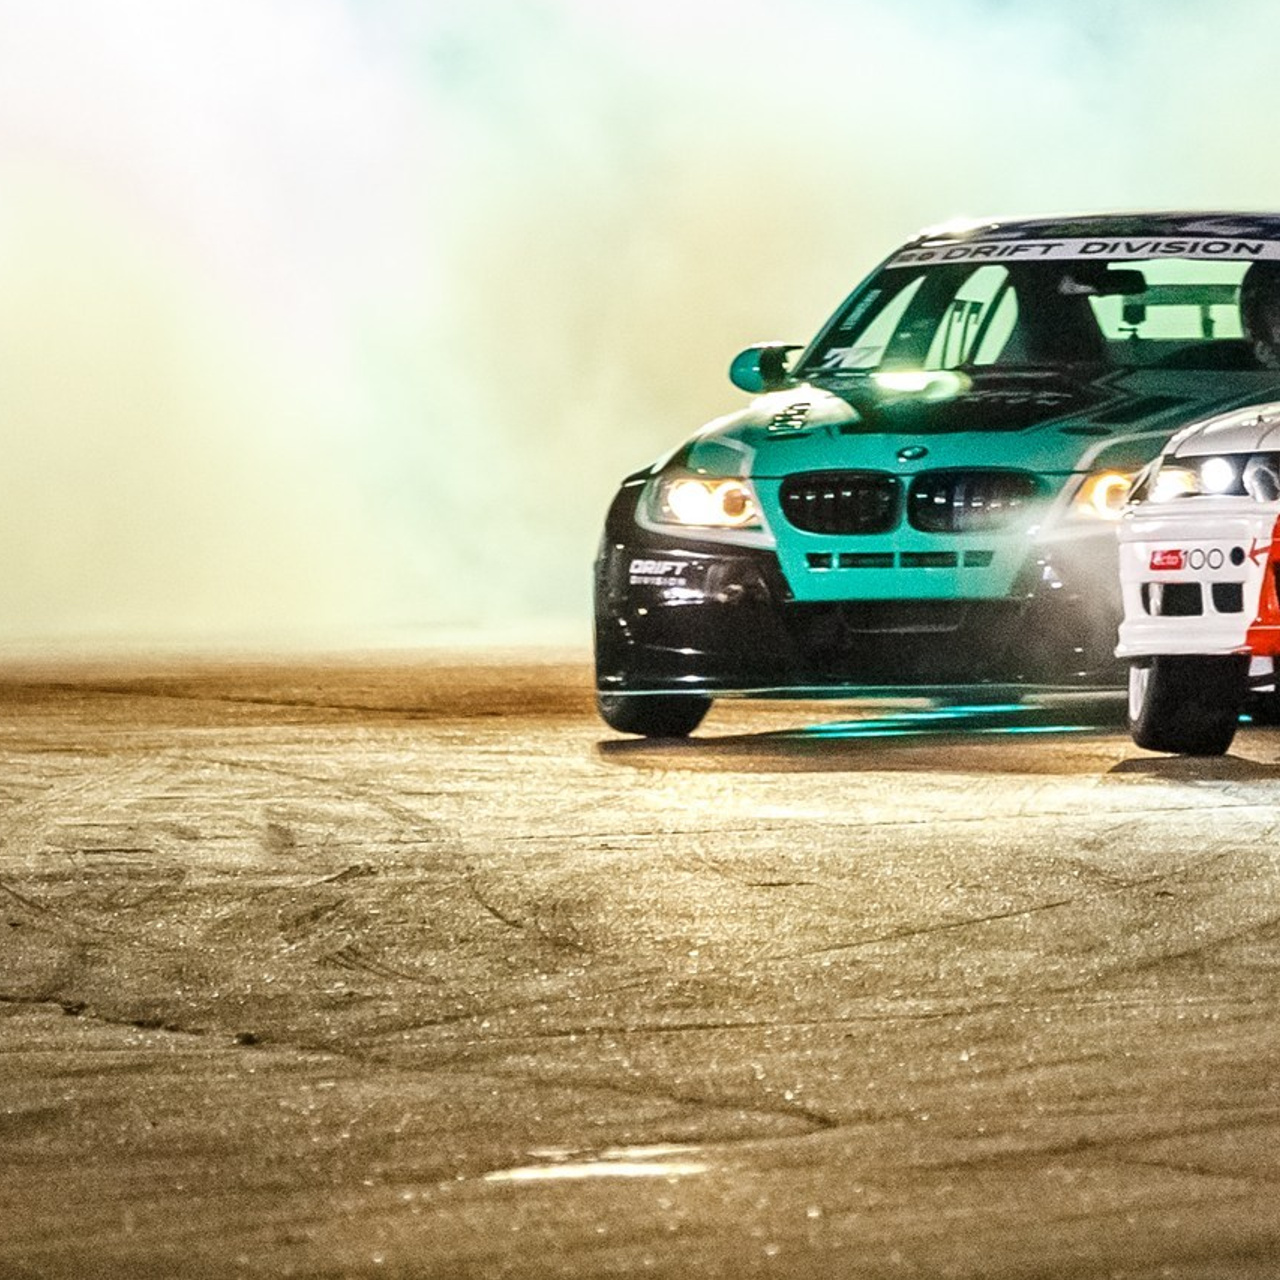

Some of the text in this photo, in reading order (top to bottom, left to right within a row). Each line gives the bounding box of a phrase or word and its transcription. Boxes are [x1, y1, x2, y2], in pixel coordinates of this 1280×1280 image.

[942, 243, 1063, 261] DRIFT
[1078, 241, 1264, 255] DIVISION
[629, 559, 689, 576] DRIFT
